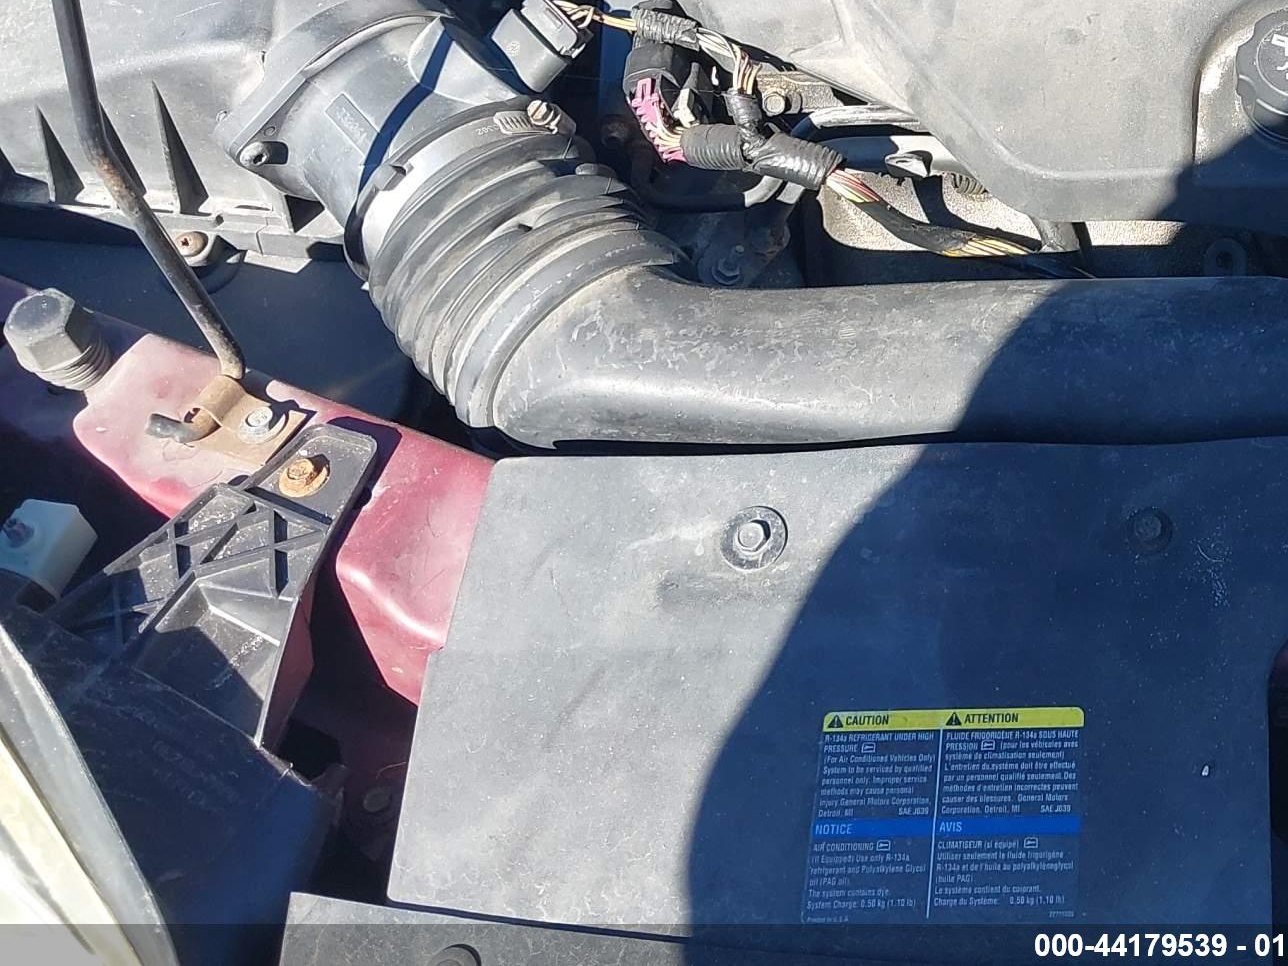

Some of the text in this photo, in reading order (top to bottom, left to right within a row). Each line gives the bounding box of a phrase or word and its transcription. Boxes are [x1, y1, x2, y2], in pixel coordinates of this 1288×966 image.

[846, 715, 889, 725] CAUTION
[964, 714, 1019, 723] ATTENTION
[947, 732, 969, 740] FLUIDE
[1039, 730, 1056, 738] SOUS
[1058, 730, 1078, 738] HAUTE
[824, 744, 857, 752] PRESSURE
[946, 742, 978, 751] PRESSION
[840, 755, 848, 763] Air
[850, 754, 888, 762] Conditioned
[890, 754, 916, 762] Vehicles
[824, 766, 846, 775] System
[895, 766, 902, 774] by
[904, 765, 932, 774] qualified
[822, 778, 854, 786] personnel
[873, 776, 901, 784] Improper
[966, 774, 999, 782] personnel
[1064, 772, 1076, 780] Des
[1014, 783, 1050, 791] incorrectes
[1052, 783, 1078, 791] peuvent
[841, 798, 866, 806] General
[1018, 794, 1043, 802] General
[816, 824, 854, 834] NOTICE
[940, 822, 962, 832] AVIS
[826, 842, 874, 852] CONDITIONING
[848, 866, 859, 874] and
[1002, 885, 1011, 893] du
